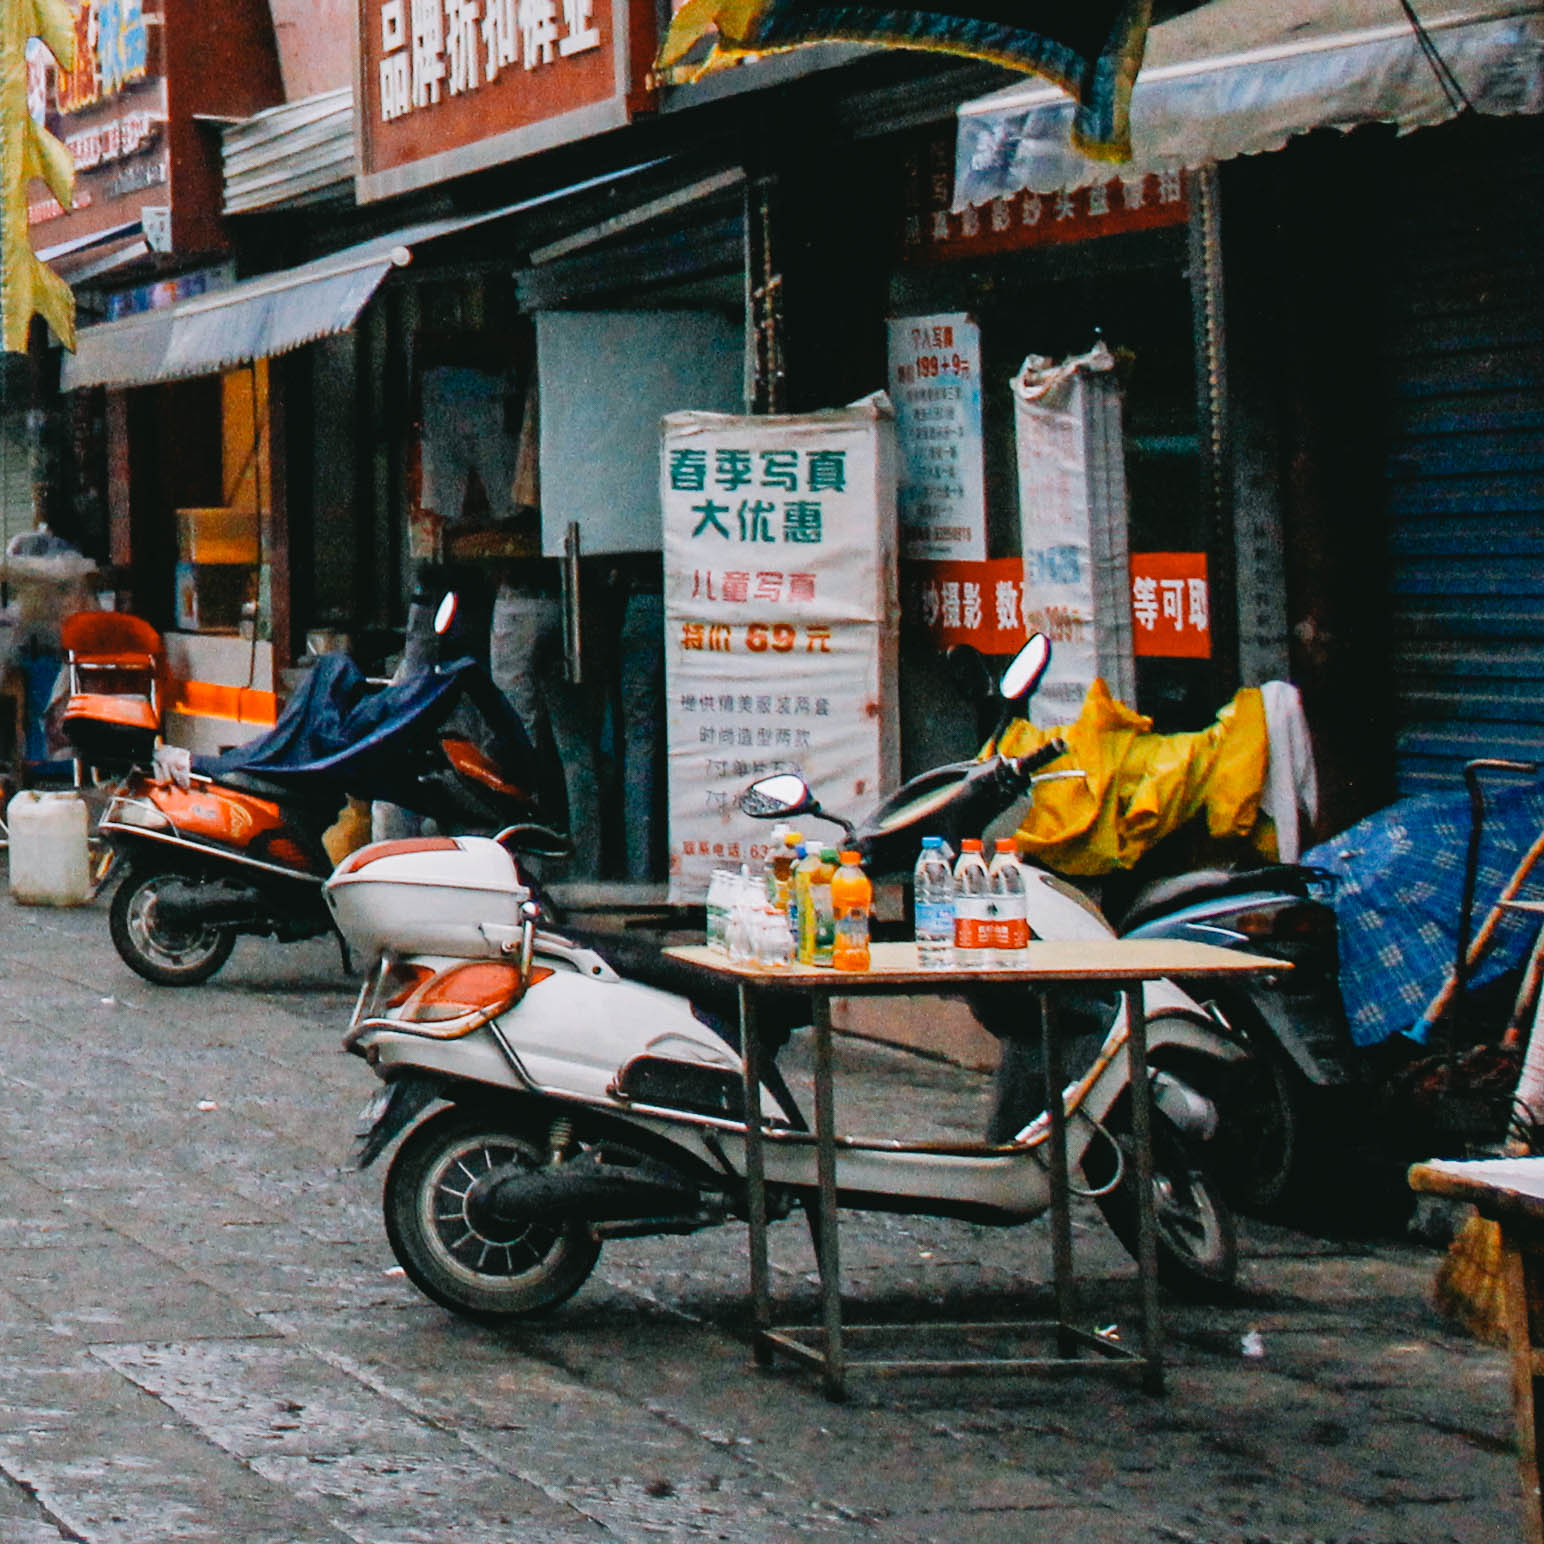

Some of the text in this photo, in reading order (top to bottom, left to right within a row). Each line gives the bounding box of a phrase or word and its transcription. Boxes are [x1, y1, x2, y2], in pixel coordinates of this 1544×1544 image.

[669, 448, 847, 493] 春季写真
[691, 498, 822, 544] 大优惠
[691, 569, 817, 603] 儿童写真
